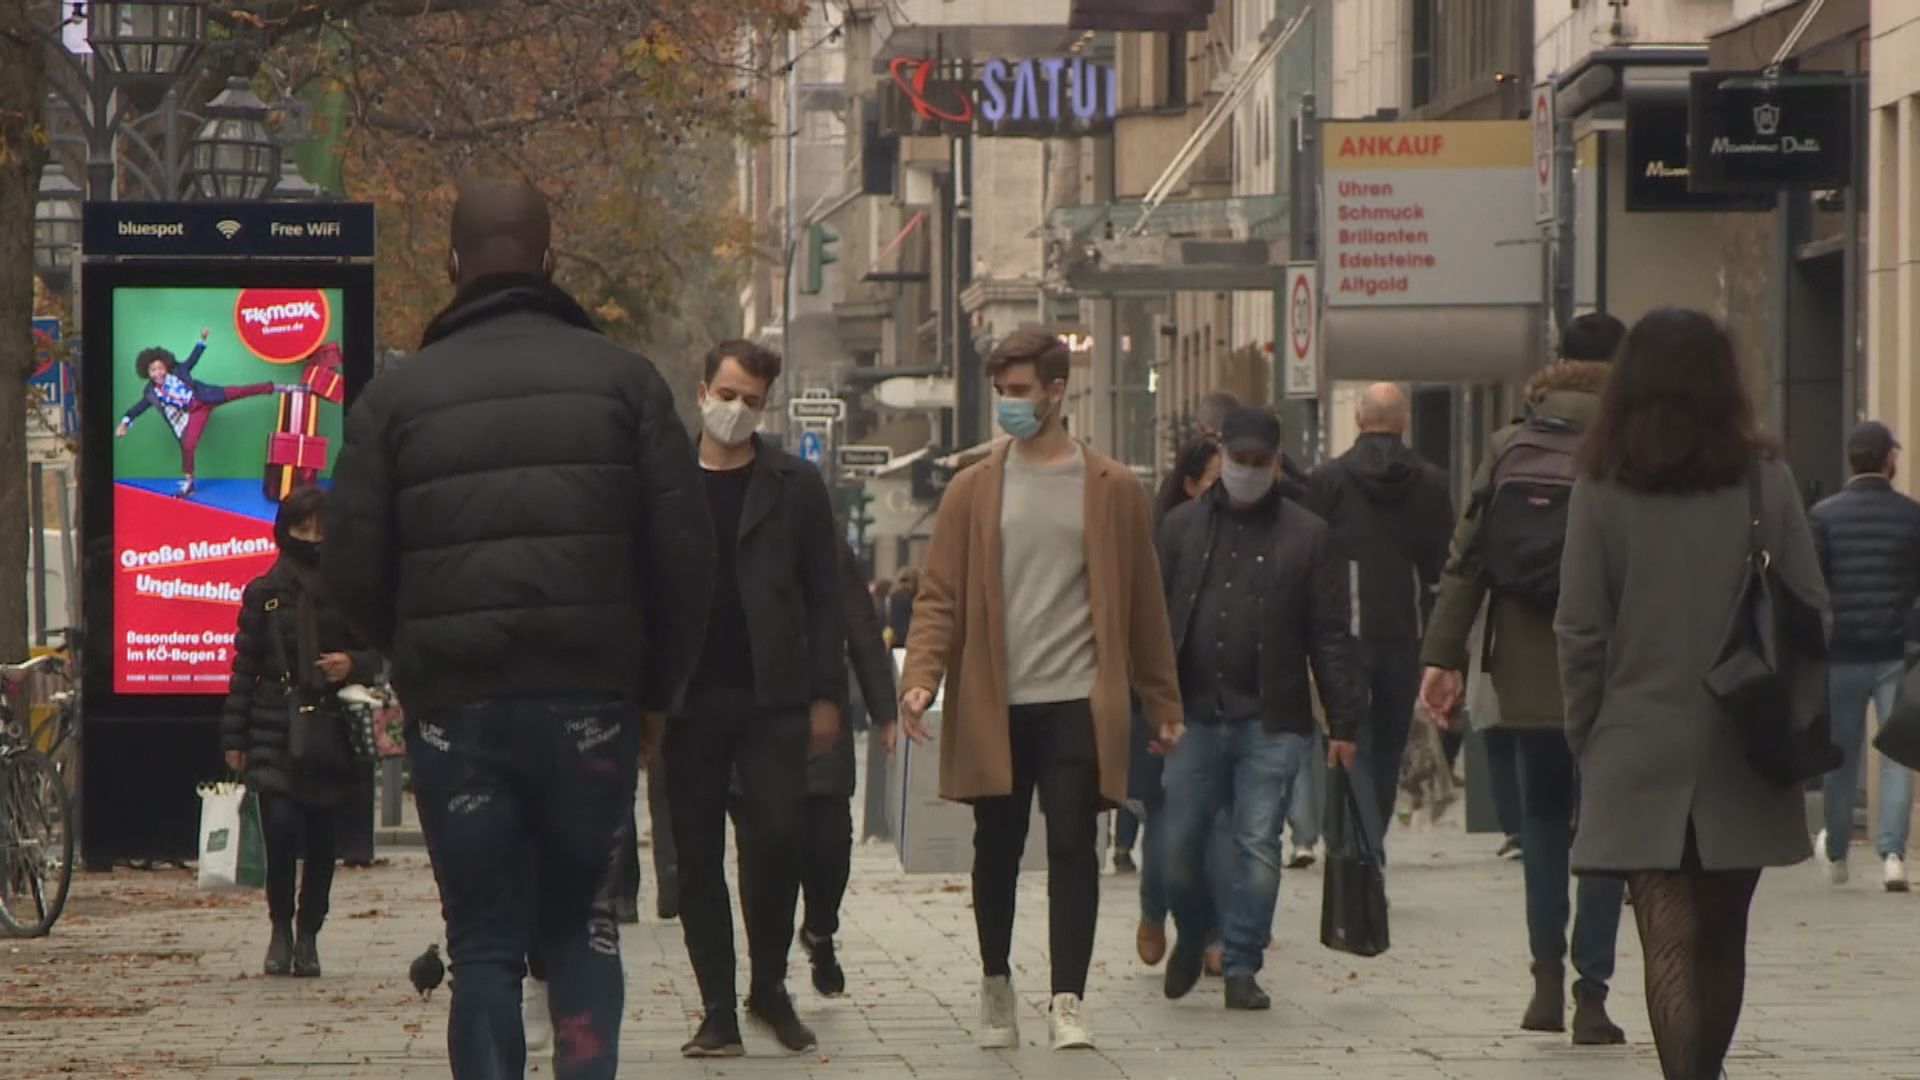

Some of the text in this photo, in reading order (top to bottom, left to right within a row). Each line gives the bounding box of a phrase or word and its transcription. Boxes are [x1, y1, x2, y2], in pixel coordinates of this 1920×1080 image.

[1338, 134, 1444, 157] ANKAUF
[1338, 180, 1393, 197] Uhren
[1338, 204, 1424, 220] Schmuck
[118, 220, 184, 239] bluespot
[271, 221, 341, 236] Free WiFi
[1338, 228, 1428, 245] Brillanten
[1338, 251, 1436, 269] Edelsteine
[1339, 276, 1409, 297] Altgold
[121, 537, 276, 567] Große Marken.
[136, 574, 246, 600] Unglaublic
[126, 631, 199, 644] Besondere
[147, 645, 214, 664] KÖ-Bogen
[218, 649, 227, 661] 2
